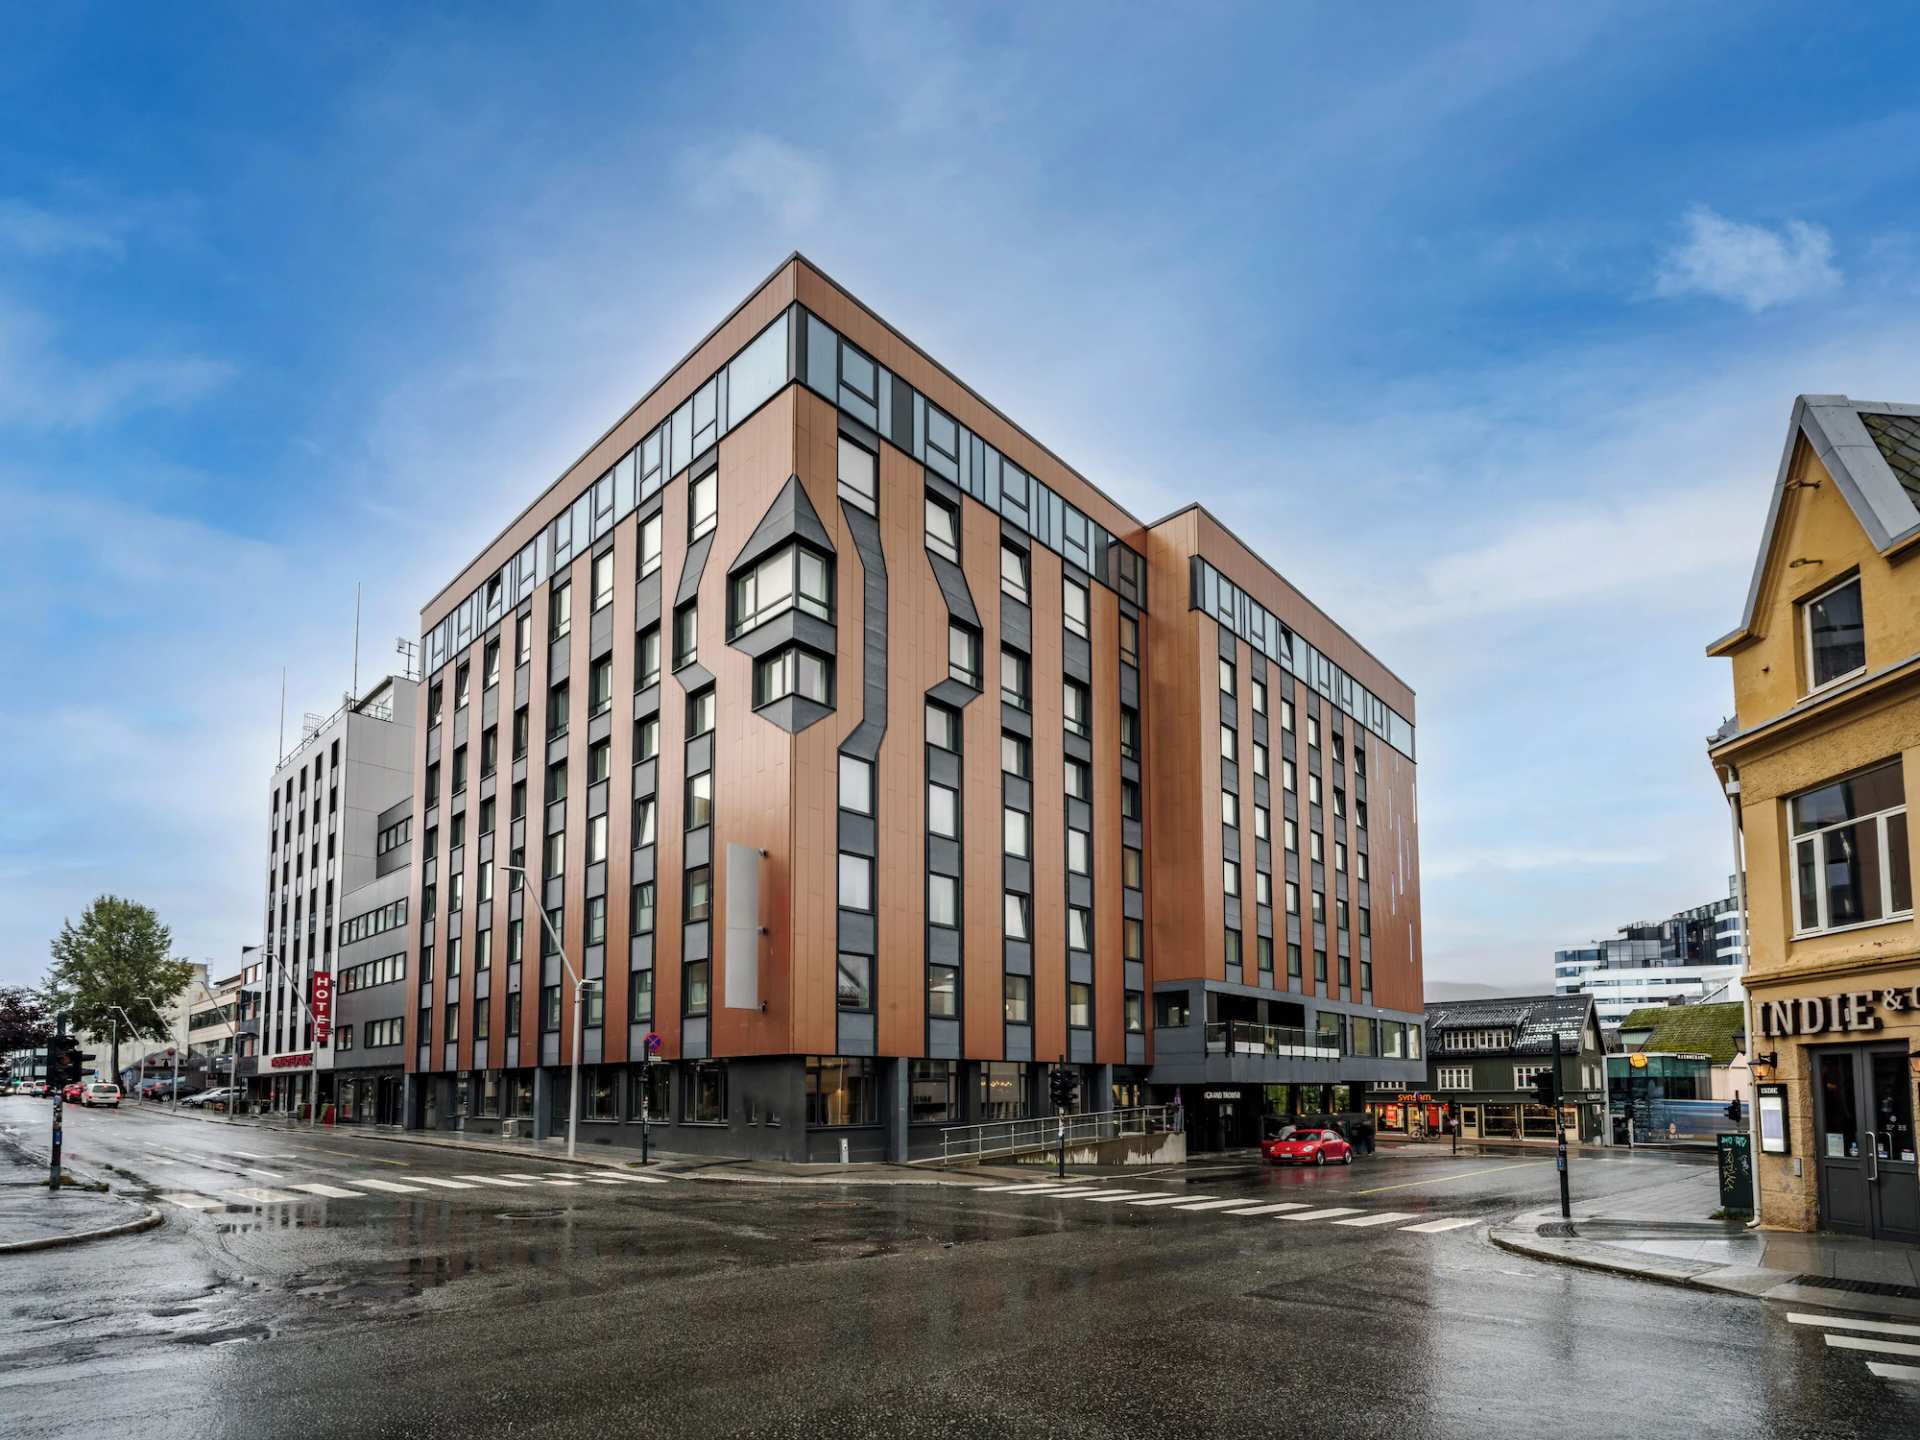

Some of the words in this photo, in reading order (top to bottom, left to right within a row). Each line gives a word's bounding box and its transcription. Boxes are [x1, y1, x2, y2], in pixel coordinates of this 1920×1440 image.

[316, 977, 329, 1037] HOTEL
[1754, 990, 1875, 1037] INDIE
[1882, 987, 1905, 1011] &
[1398, 1094, 1431, 1102] synam
